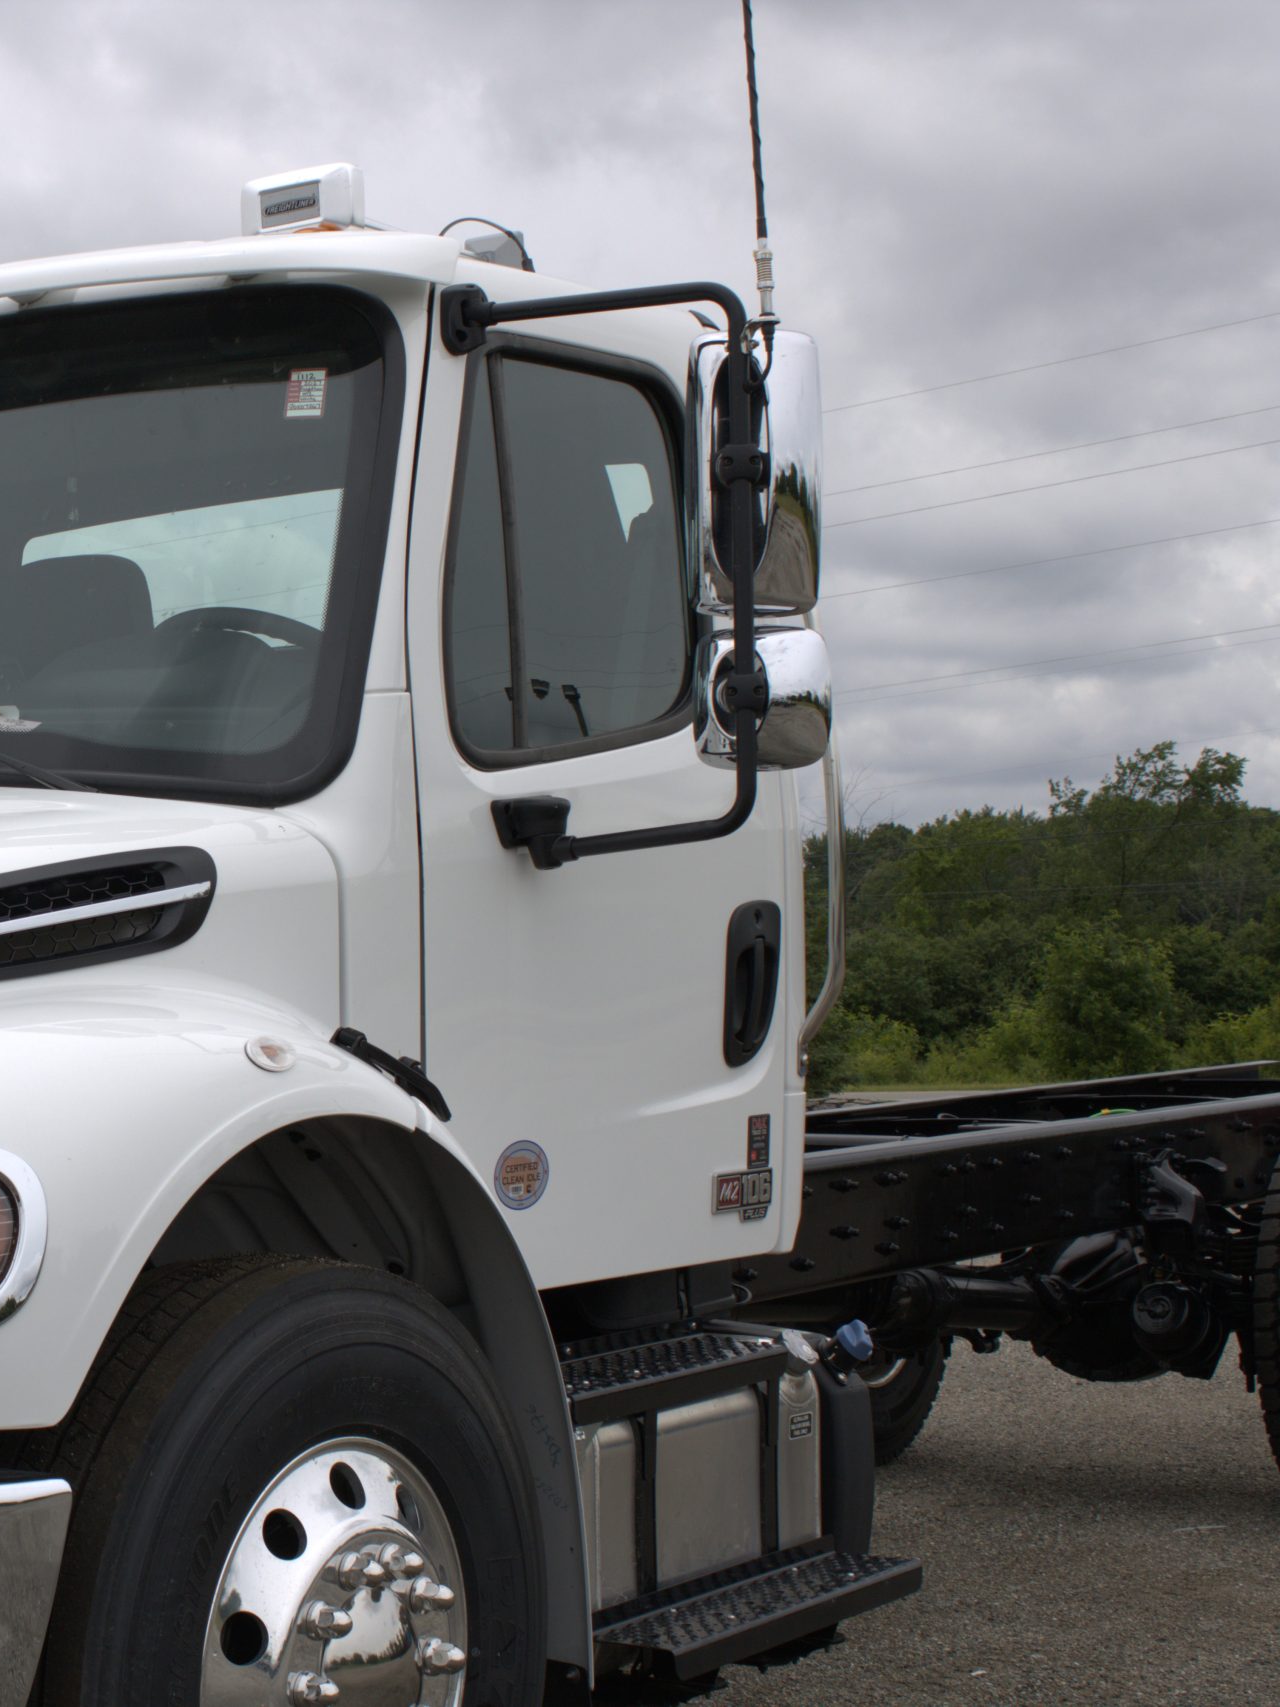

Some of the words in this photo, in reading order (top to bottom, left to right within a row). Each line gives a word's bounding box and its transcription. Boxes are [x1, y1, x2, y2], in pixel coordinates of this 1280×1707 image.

[505, 1162, 538, 1173] CERTIFIED
[502, 1175, 524, 1186] CLEAN
[527, 1172, 541, 1182] IDLE
[720, 1181, 739, 1203] M2
[742, 1172, 770, 1205] 106
